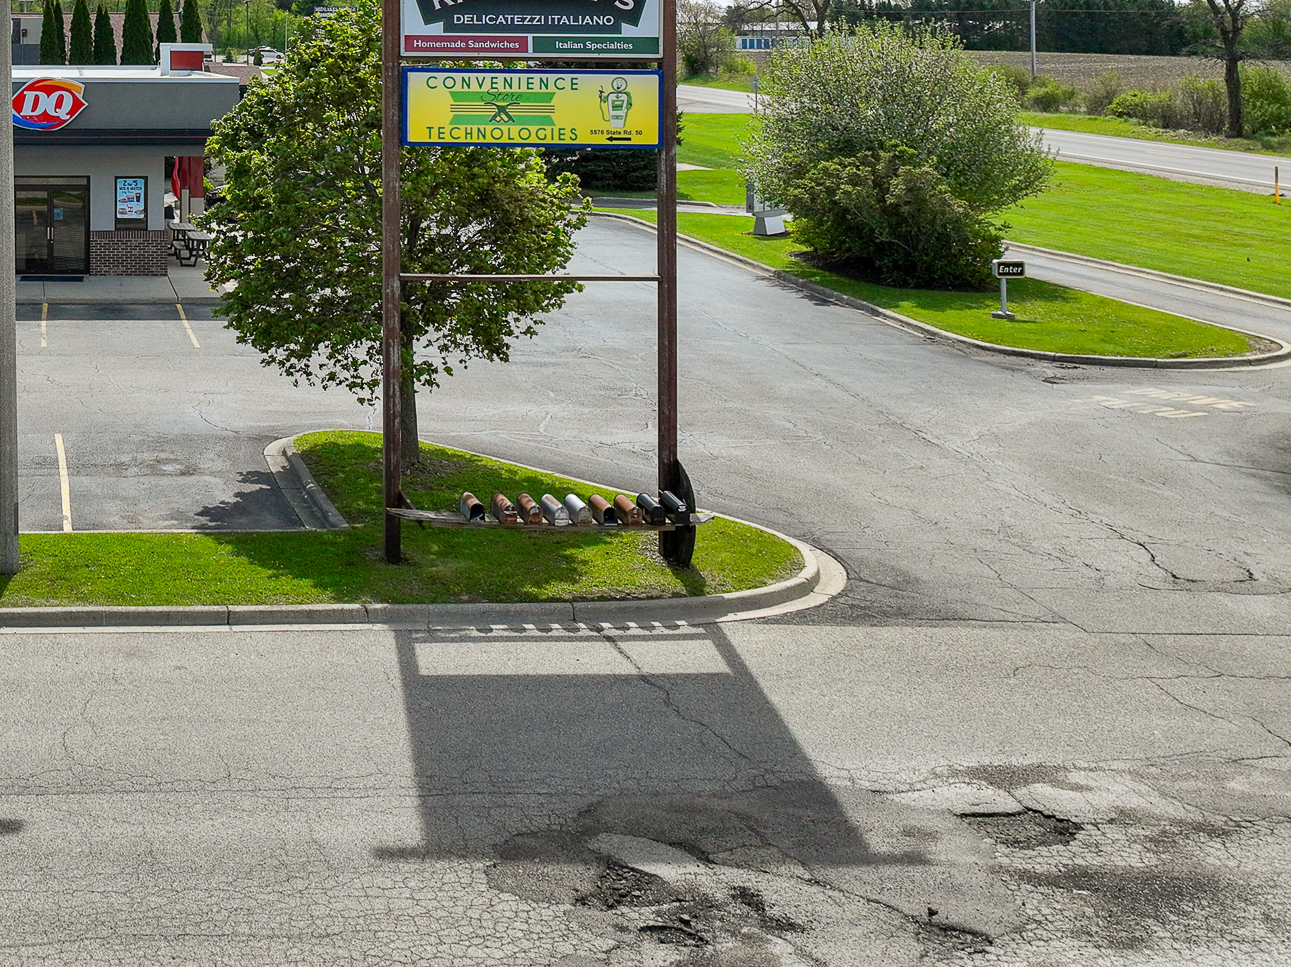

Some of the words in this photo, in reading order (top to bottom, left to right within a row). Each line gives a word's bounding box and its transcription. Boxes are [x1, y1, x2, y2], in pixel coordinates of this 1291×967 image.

[453, 14, 545, 26] DELICATEZZI
[548, 14, 615, 26] ITALIANO
[413, 39, 467, 49] Homemade
[468, 39, 520, 49] Sandwiches
[555, 40, 584, 50] Italian
[585, 40, 634, 52] Specialties
[426, 75, 580, 91] CONVENIENCE
[480, 87, 524, 103] Store
[20, 90, 73, 120] DQ
[425, 126, 579, 141] TECHNOLOGIES
[999, 265, 1023, 273] Enter
